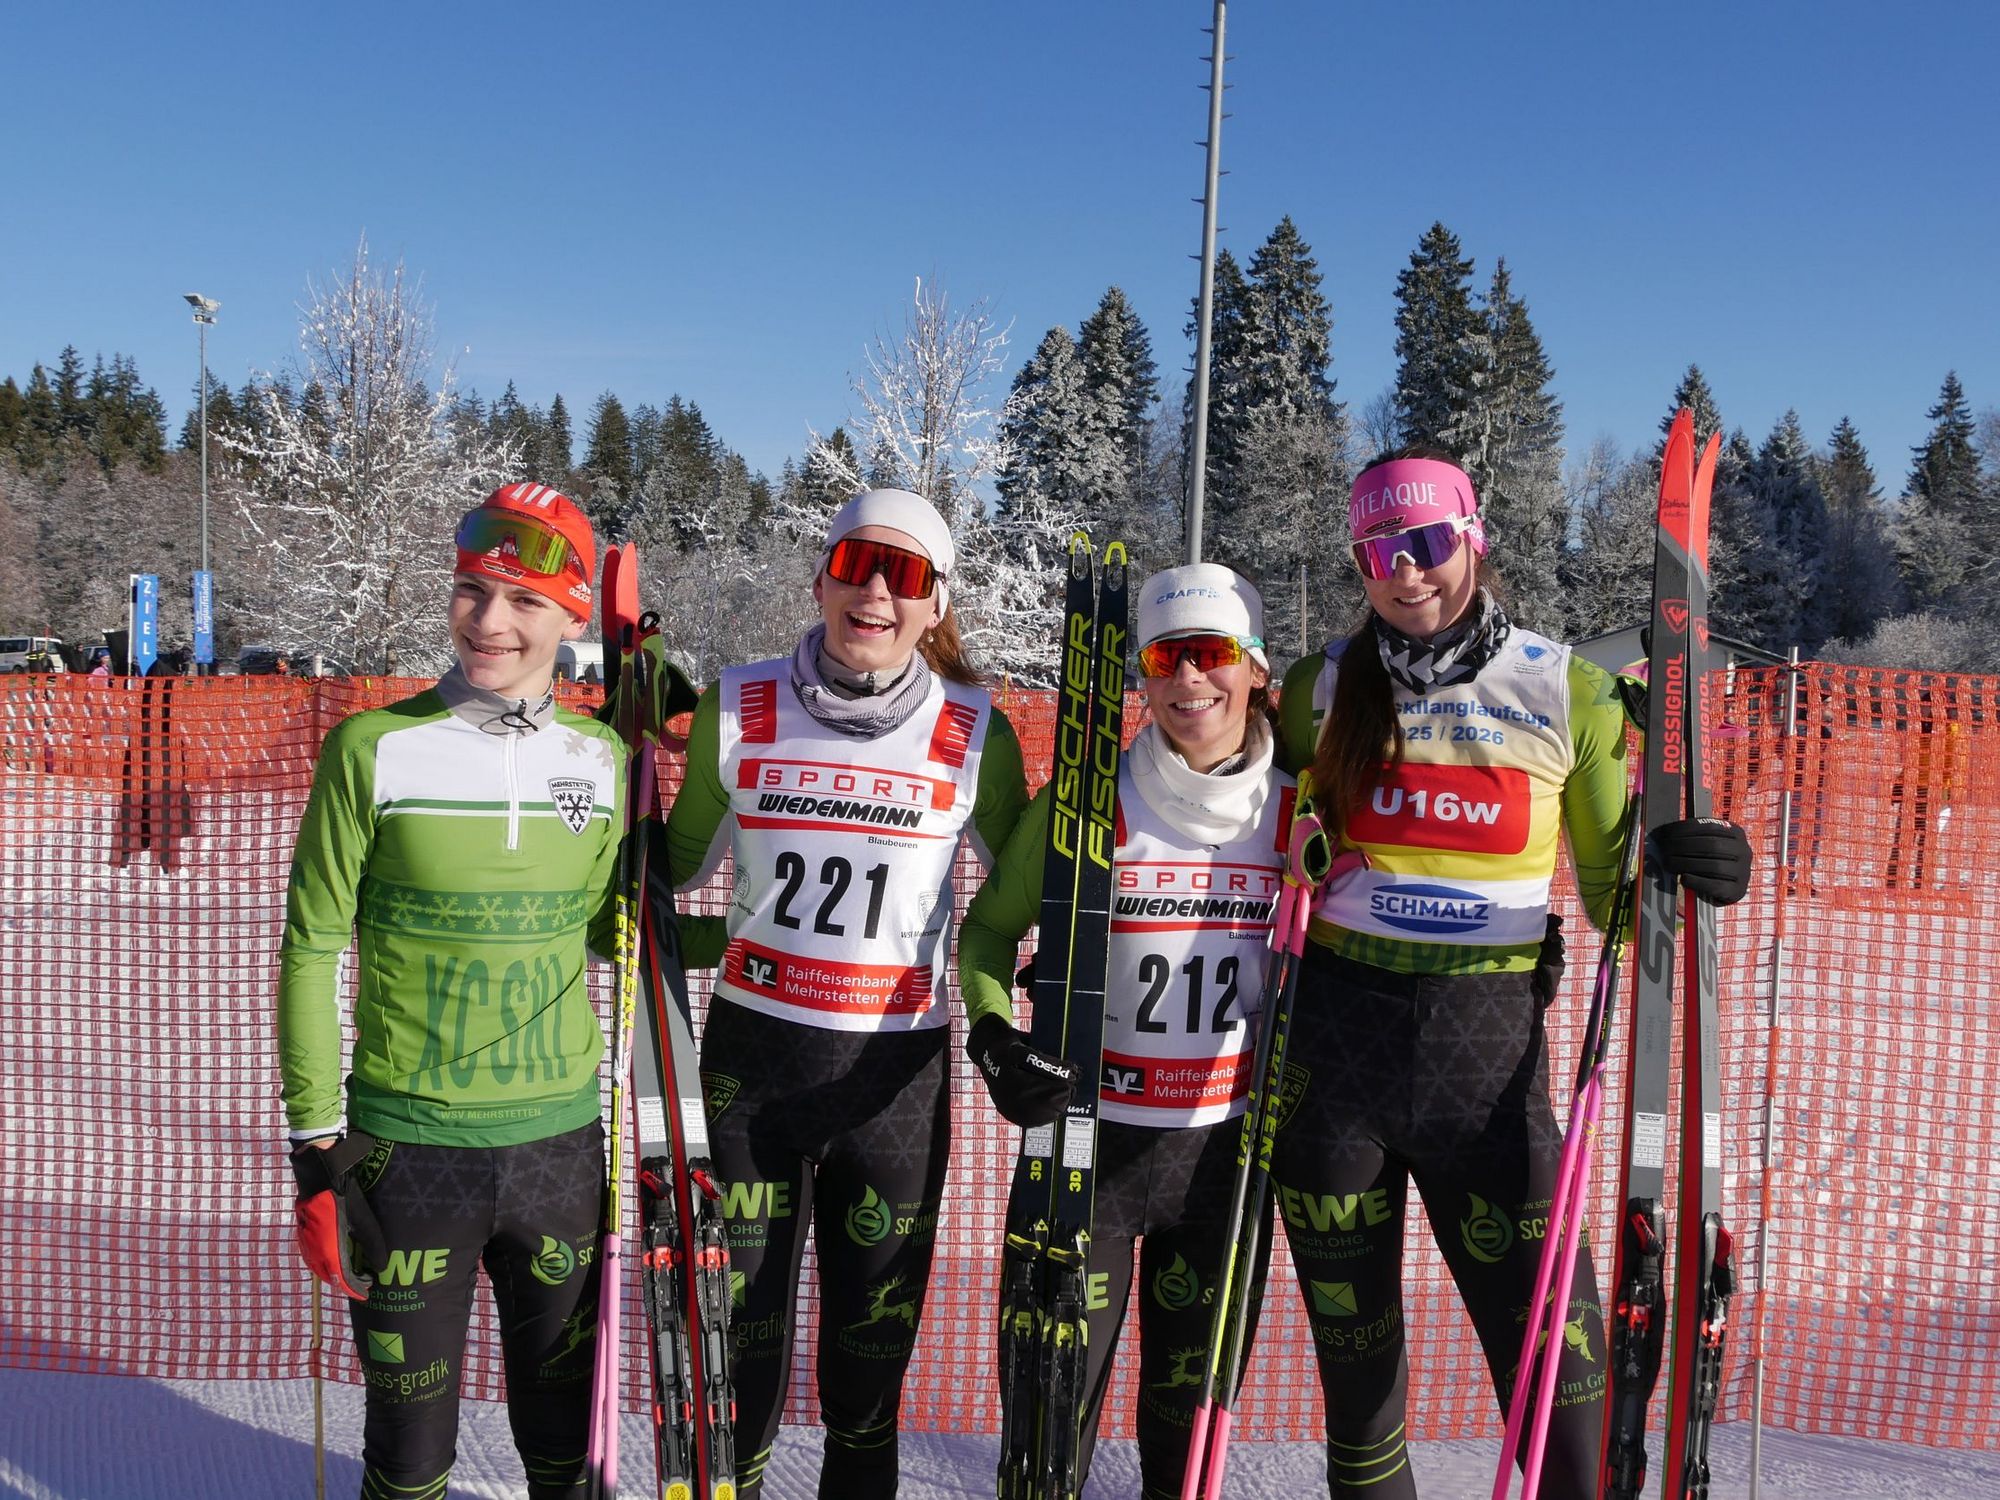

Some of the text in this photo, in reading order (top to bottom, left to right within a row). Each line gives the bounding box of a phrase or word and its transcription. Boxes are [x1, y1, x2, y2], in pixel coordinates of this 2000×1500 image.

[1350, 481, 1440, 530] OTEAQUE
[568, 587, 591, 603] adidas
[1156, 588, 1206, 605] CRAFT
[143, 580, 151, 656] ZIEL
[1663, 653, 1684, 775] ROSSIGNOL
[1053, 612, 1092, 860] FISCHER
[1452, 725, 1504, 745] 2026
[1701, 671, 1712, 790] ROSSIGNOL
[1088, 623, 1126, 870] FISCHER
[551, 780, 593, 791] MEHRSTETTEN
[763, 768, 925, 801] SPORT
[757, 793, 923, 828] WIEDENMANN
[1371, 787, 1502, 824] U16w
[867, 835, 919, 850] Blaubeuren
[1119, 870, 1276, 893] SPORT
[773, 850, 890, 940] 221
[1370, 893, 1489, 921] SCHMALZ
[1115, 896, 1274, 921] WIEDENMANN
[785, 964, 898, 988] Raiffeisenbank
[784, 980, 904, 1005] Mehrstetten eG
[1136, 954, 1240, 1034] 212
[408, 952, 568, 1093] XC SKI
[1154, 1080, 1239, 1098] Mehrstetten
[440, 1107, 542, 1120] WSV MEHRSTETTEN
[1029, 1159, 1043, 1182] 3D
[1068, 1169, 1082, 1193] 3D
[720, 1180, 792, 1220] WE
[731, 1224, 764, 1235] OHG
[386, 1290, 419, 1301] OHG
